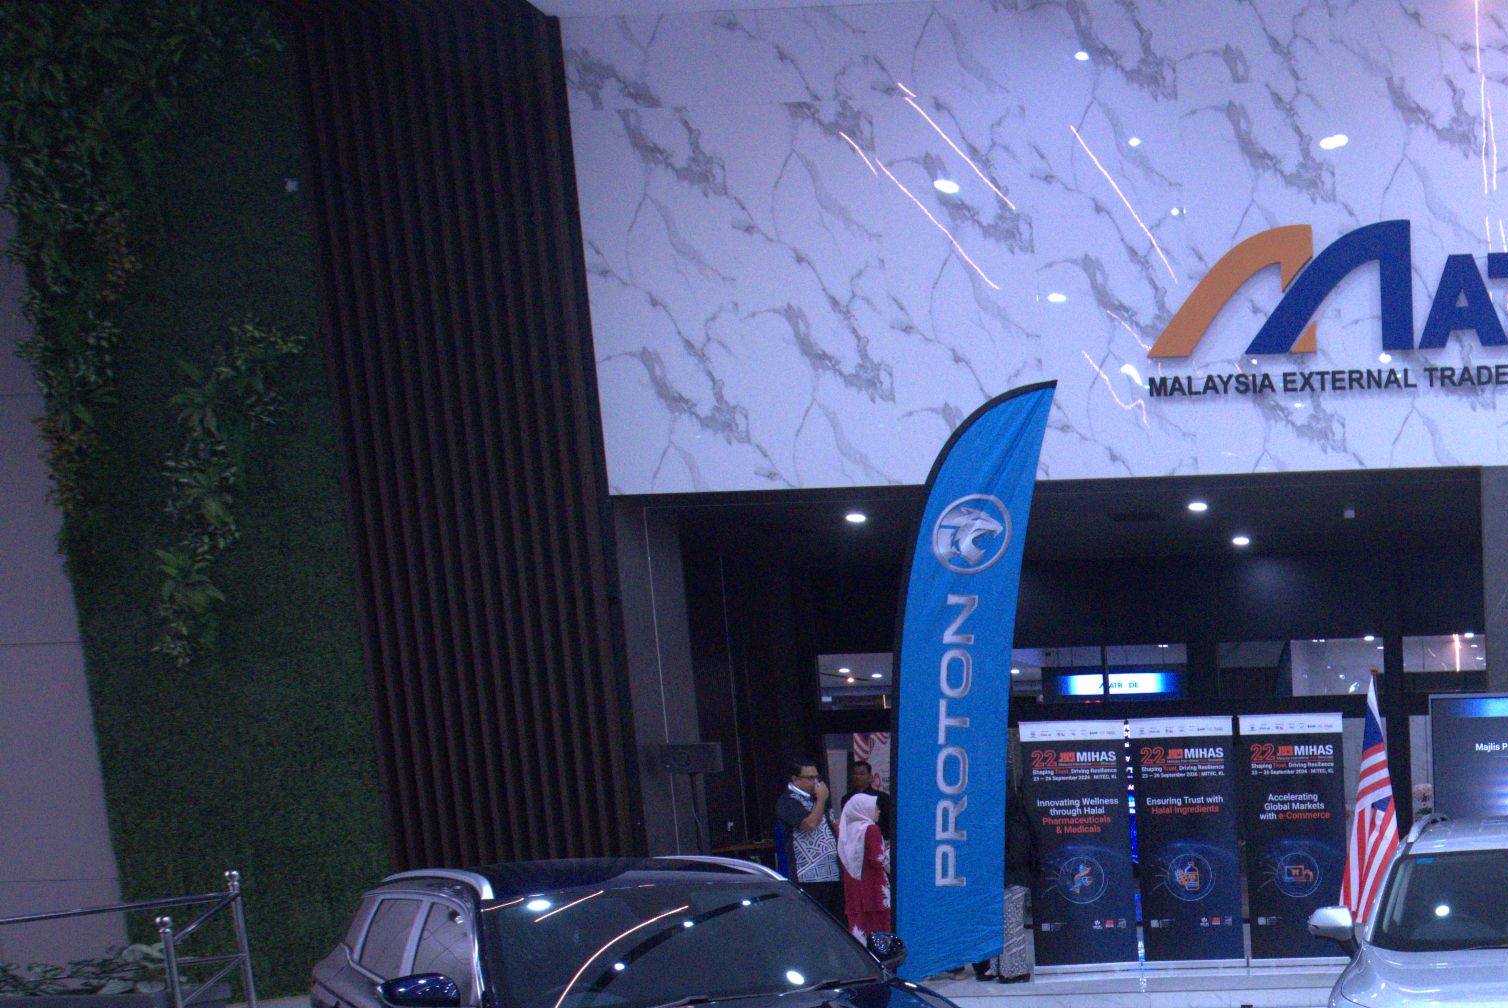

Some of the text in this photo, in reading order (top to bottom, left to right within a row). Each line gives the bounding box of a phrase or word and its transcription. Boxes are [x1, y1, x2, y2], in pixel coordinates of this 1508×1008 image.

[1149, 373, 1276, 397] MALAYSIA
[1283, 368, 1417, 392] EXTERNAL
[1424, 364, 1508, 388] TRADE
[936, 594, 978, 887] PROTON
[1250, 743, 1333, 761] 22 MIHAS
[1475, 743, 1500, 752] Majlis
[1031, 750, 1116, 768] 22 MIHAS
[1140, 746, 1224, 765] 22 MIHAS
[1146, 797, 1182, 806] Ensuring
[1268, 793, 1318, 801] Accelerating
[1037, 798, 1080, 807] Innovating
[1050, 808, 1081, 816] through
[1152, 805, 1219, 815] Halal Ingredients
[1042, 816, 1111, 824] Pharmaceuticals
